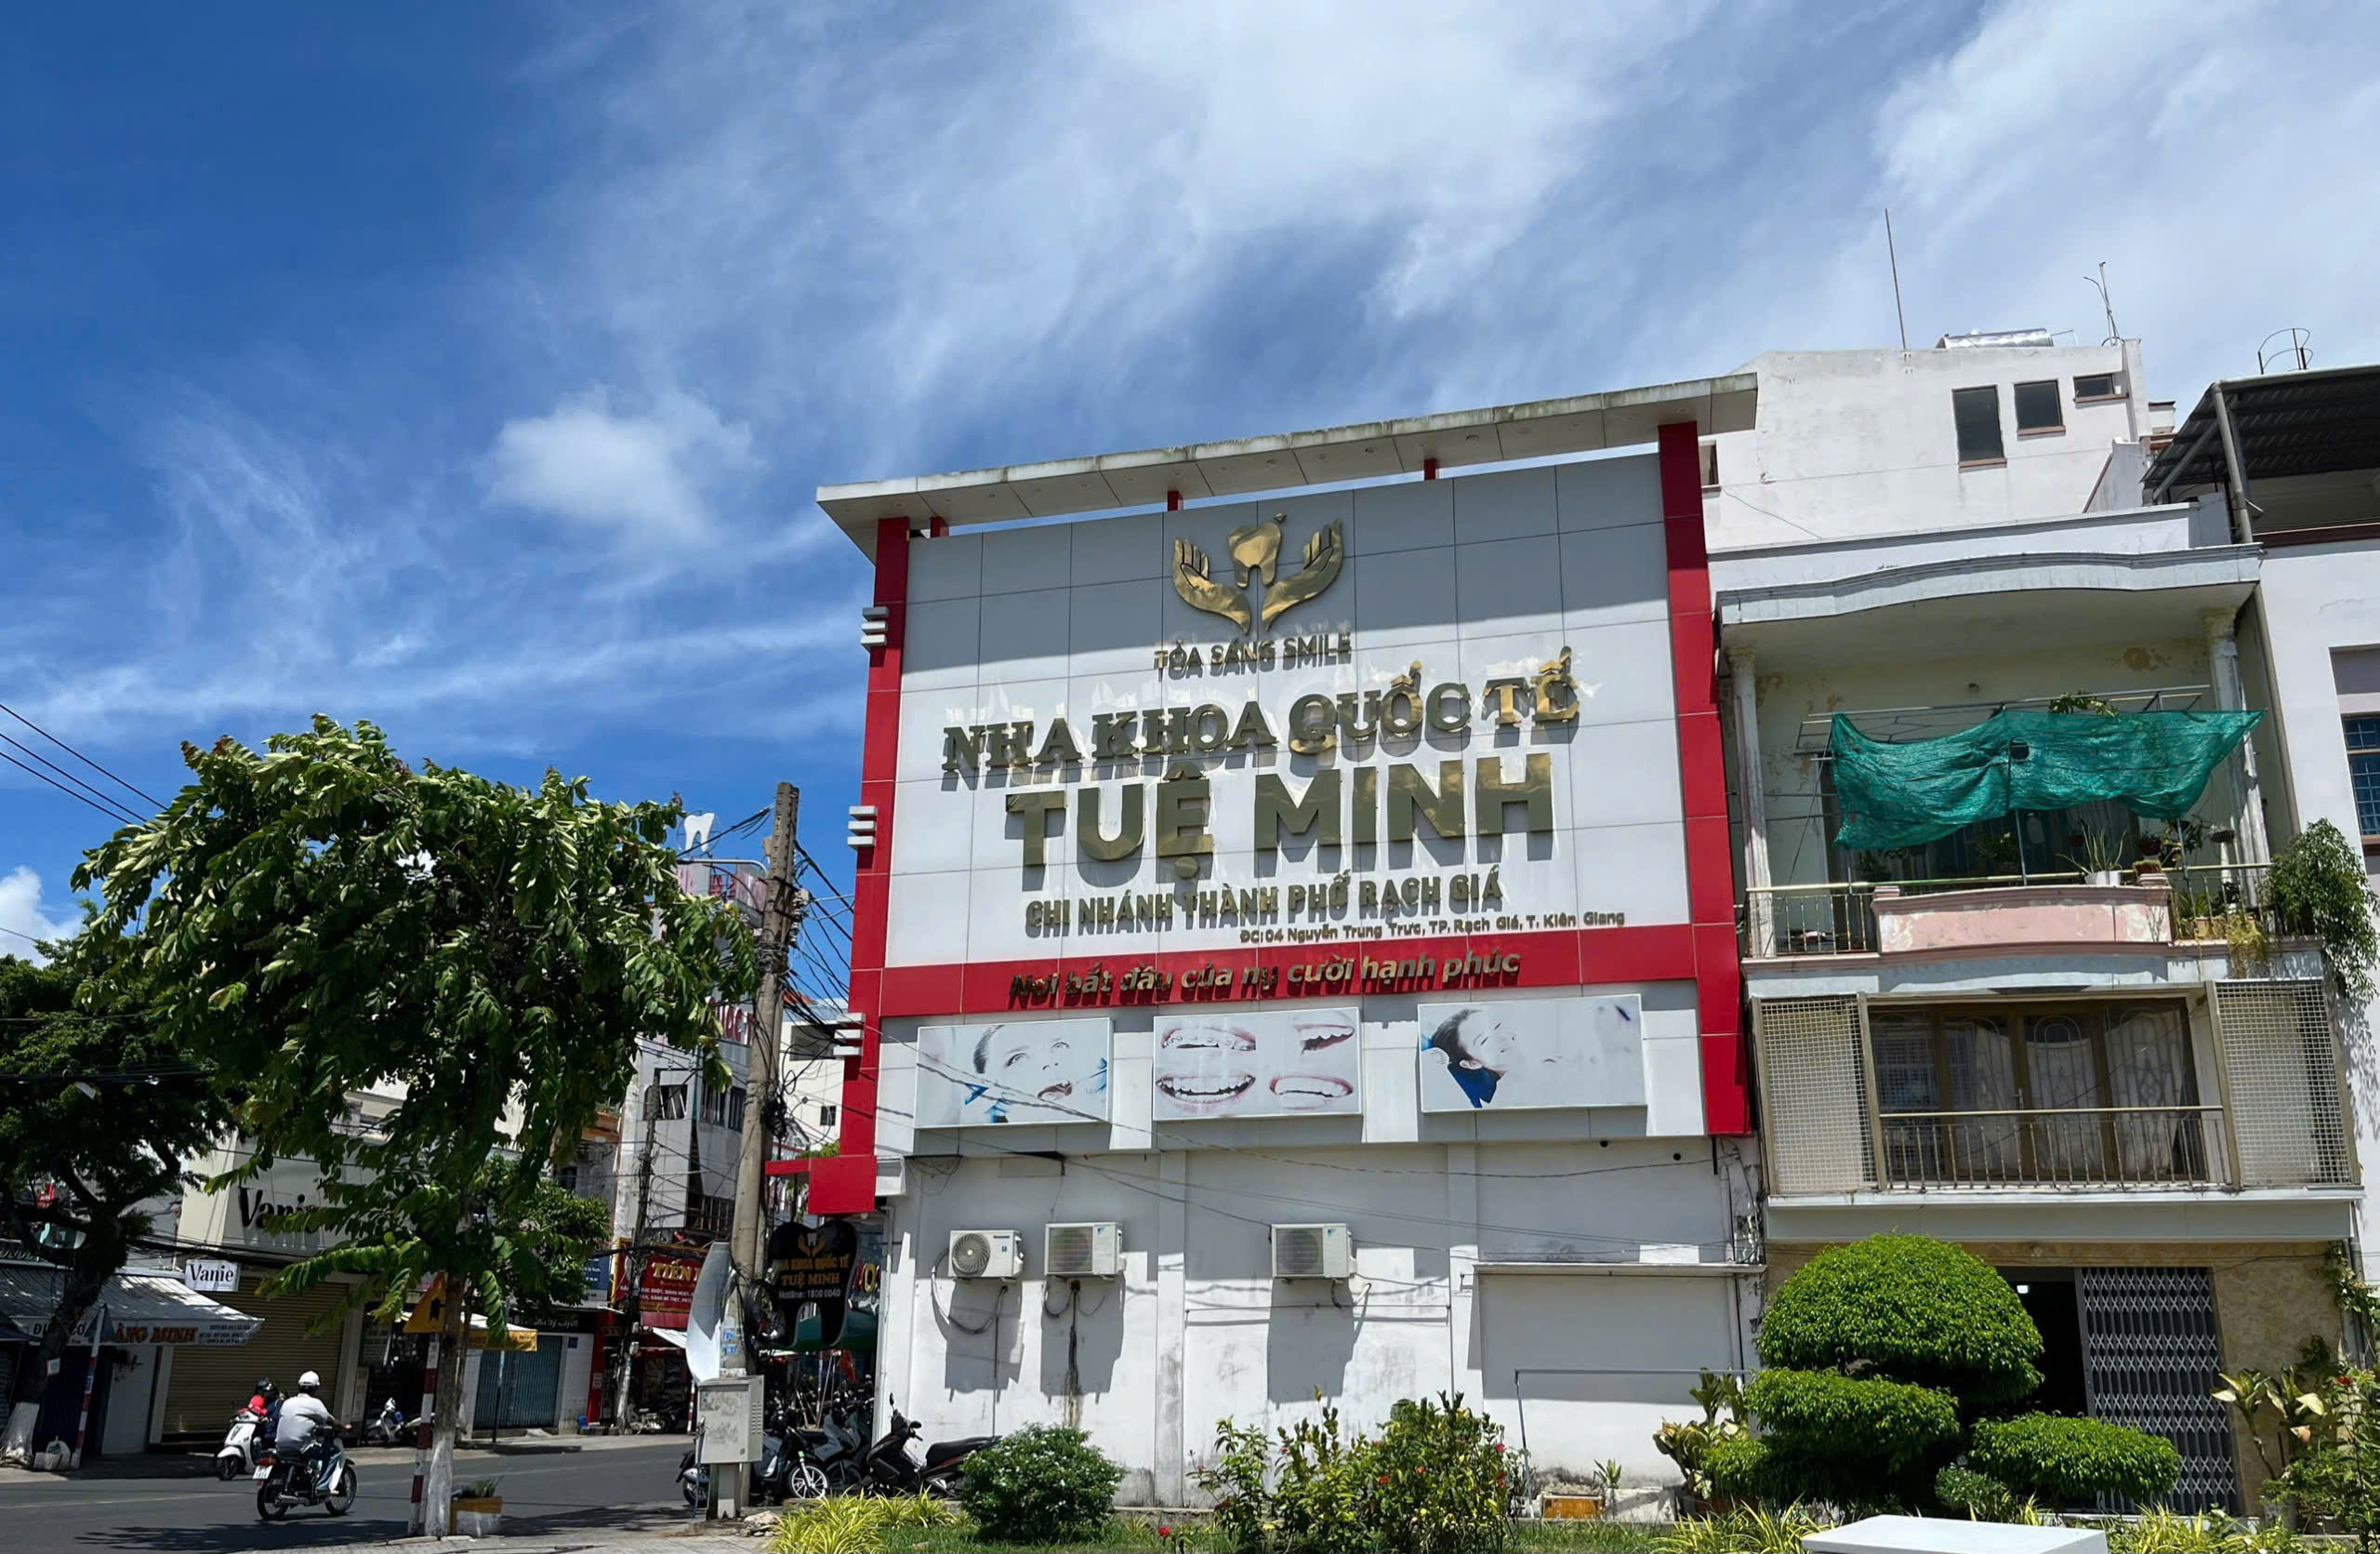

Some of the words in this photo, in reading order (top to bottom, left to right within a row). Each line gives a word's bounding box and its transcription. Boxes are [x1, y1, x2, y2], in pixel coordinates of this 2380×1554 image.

[1211, 638, 1275, 664] SÁNG
[1283, 632, 1352, 657] SMILE
[942, 718, 1083, 770] NHA
[1091, 701, 1278, 758] KHOA
[1289, 660, 1471, 754] QUỐC
[1482, 646, 1580, 724] TẾ
[1006, 762, 1213, 878] TUỆ
[1255, 752, 1553, 849] MINH
[1026, 899, 1070, 926] CHI
[1079, 890, 1173, 922] NHÁNH
[1183, 883, 1278, 919] THÀNH
[1289, 870, 1351, 910] PHỐ
[1359, 876, 1440, 910] RẠCH
[1449, 865, 1502, 901] GIÁ
[1288, 924, 1338, 944] Nguyễn
[1343, 925, 1382, 940] Trung
[1543, 911, 1577, 927] Kiên
[1583, 911, 1625, 927] Giang
[1010, 972, 1059, 997] Nơi
[1065, 962, 1113, 994] bắt
[1120, 962, 1172, 991] đầu
[1181, 962, 1233, 989] của
[1242, 965, 1279, 990] nụ
[1288, 954, 1354, 983] cười
[1361, 952, 1435, 984] hạnh
[1442, 948, 1521, 983] phúc
[189, 1263, 234, 1282] Vanie
[781, 1271, 804, 1288] TUỆ
[808, 1271, 840, 1285] MINH
[807, 1289, 823, 1298] 1800
